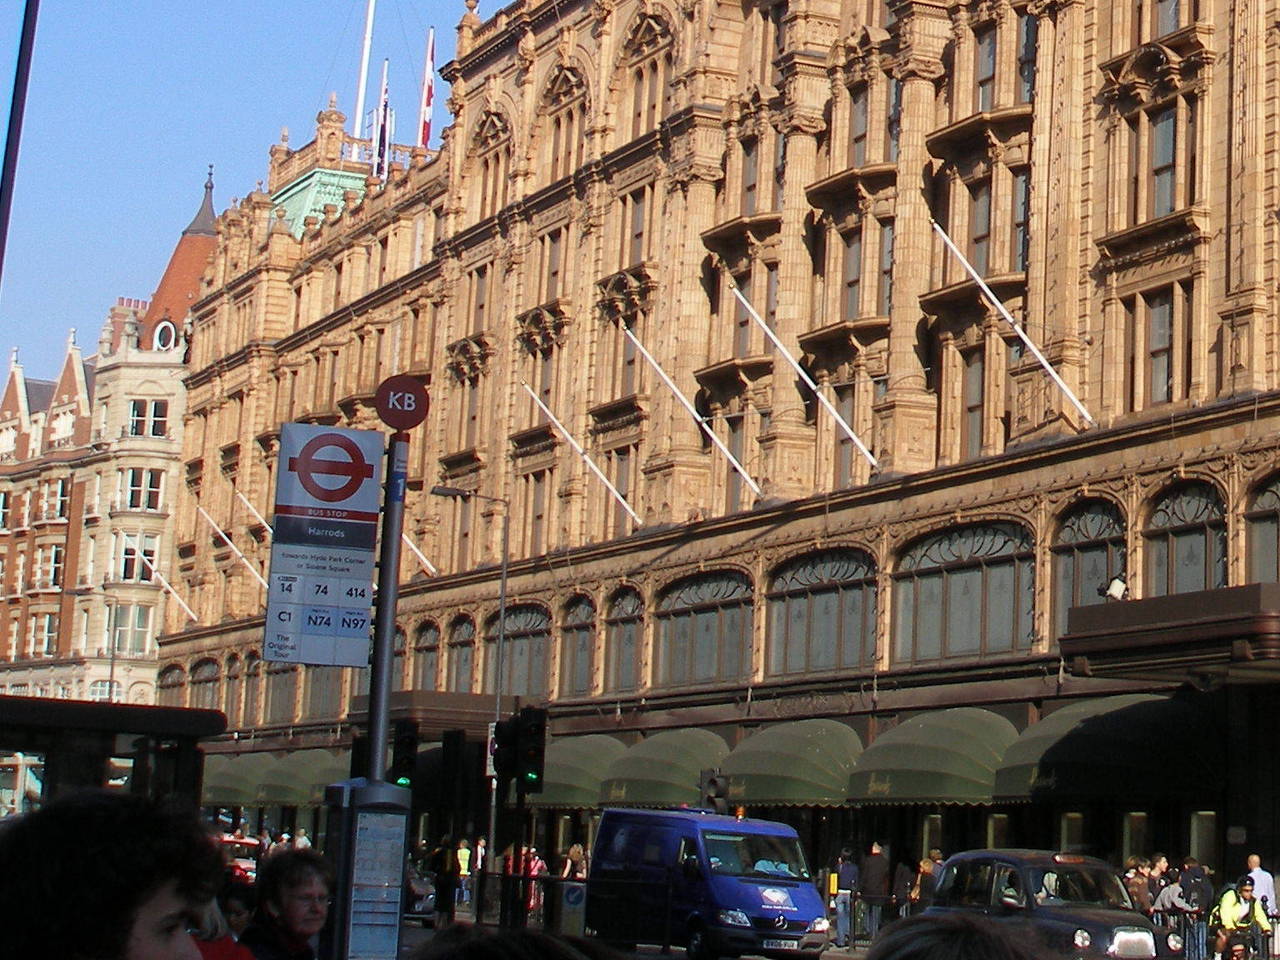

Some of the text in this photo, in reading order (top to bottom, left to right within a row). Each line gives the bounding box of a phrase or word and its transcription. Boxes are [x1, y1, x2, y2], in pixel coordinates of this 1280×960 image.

[388, 391, 416, 411] KB
[308, 508, 348, 518] BUS STOP
[308, 526, 345, 538] Harrods
[344, 556, 366, 564] Corner
[280, 583, 293, 593] 14
[315, 584, 329, 595] 74
[346, 587, 366, 598] 414
[278, 611, 292, 622] C1
[308, 615, 331, 627] N74
[342, 618, 366, 629] N97
[268, 642, 296, 651] Original
